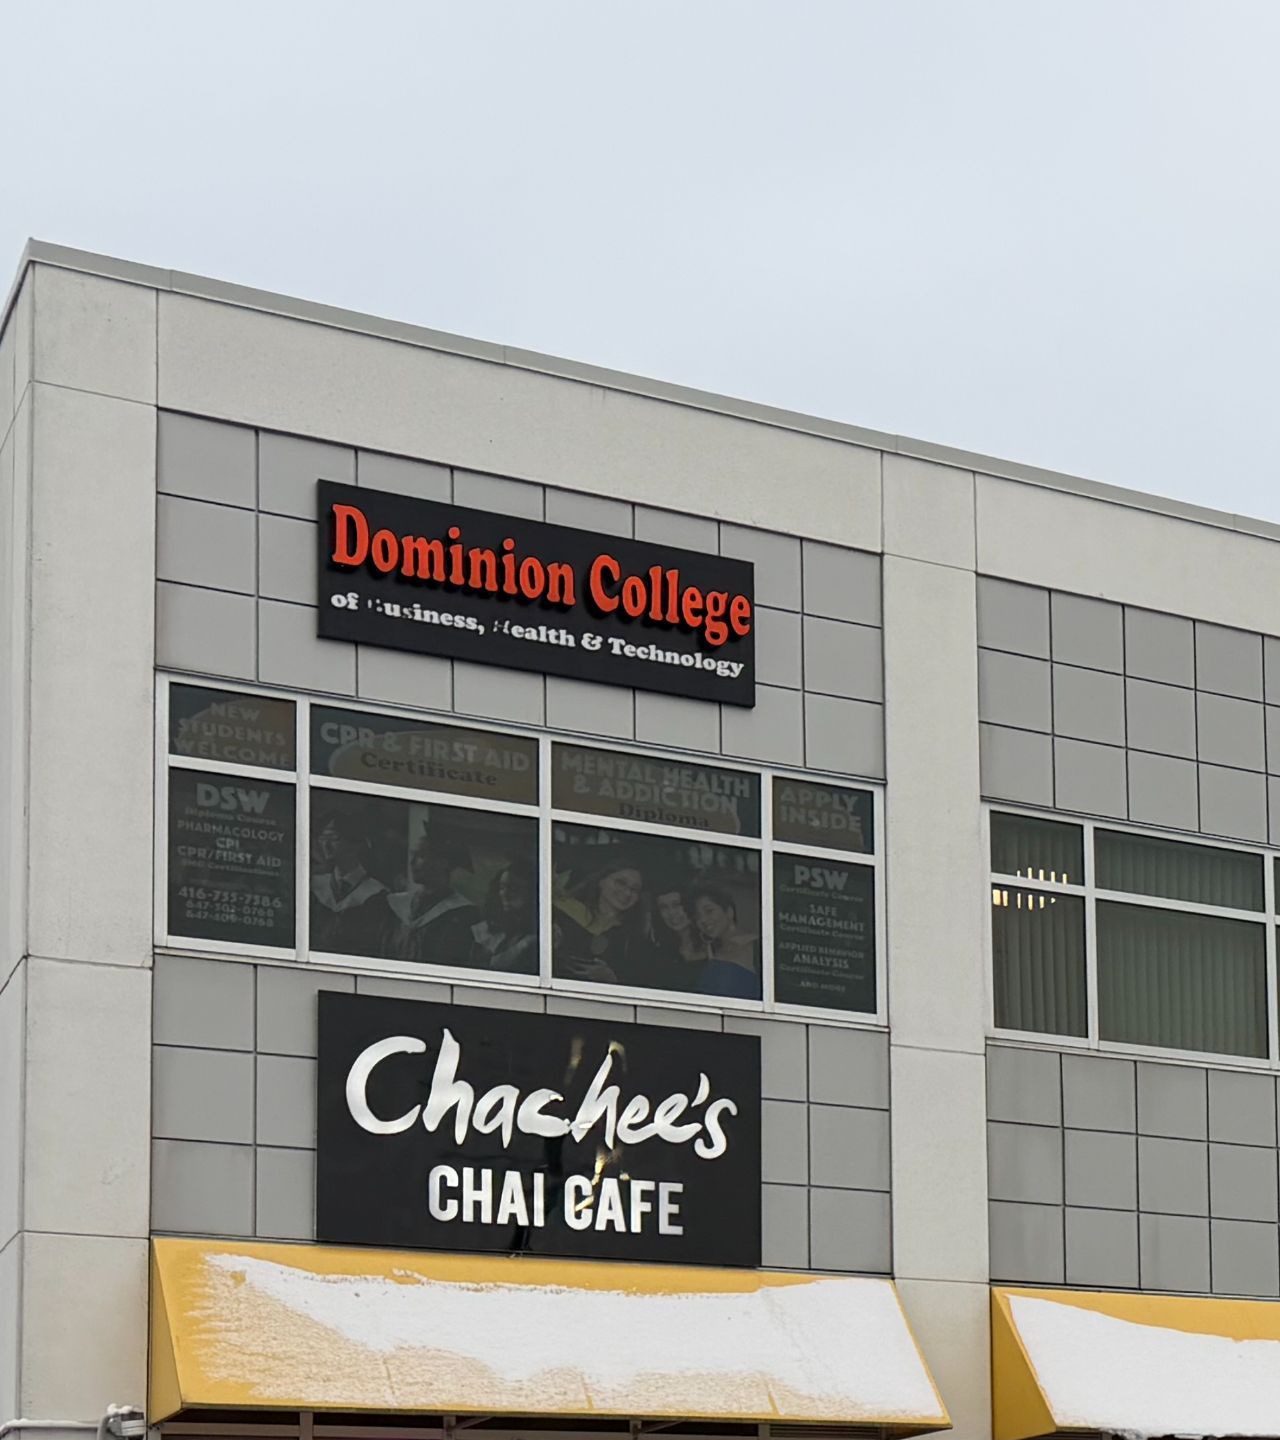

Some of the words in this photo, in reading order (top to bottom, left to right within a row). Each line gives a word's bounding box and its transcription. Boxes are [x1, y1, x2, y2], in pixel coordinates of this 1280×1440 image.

[331, 503, 577, 606] Dominion
[590, 554, 751, 646] College
[331, 592, 359, 611] of
[580, 632, 601, 651] &
[608, 637, 745, 679] Technology
[210, 702, 261, 722] NEW
[178, 717, 286, 748] STUDENTS
[320, 721, 376, 748] CPR
[382, 734, 401, 752] &
[408, 735, 479, 765] FIRST
[485, 749, 530, 772] AID
[173, 737, 290, 769] WELCOME
[360, 751, 498, 787] Certificate
[560, 751, 657, 785] MENTAL
[662, 768, 751, 799] HEALTH
[196, 782, 271, 815] DSW
[574, 773, 590, 793] &
[602, 780, 739, 815] ADDICTION
[780, 785, 859, 813] APPLY
[176, 819, 285, 843] PHARMACOLOGY
[617, 802, 710, 829] Diploma
[780, 804, 863, 833] INSIDE
[256, 855, 282, 868] AID
[794, 864, 849, 891] PSW
[778, 911, 865, 933] MANAGEMENT
[809, 903, 837, 917] SAFE
[793, 953, 850, 970] ANALYSIS
[345, 1028, 738, 1160] Chachee's
[428, 1164, 546, 1228] CHAI
[564, 1173, 684, 1237] CAFE
